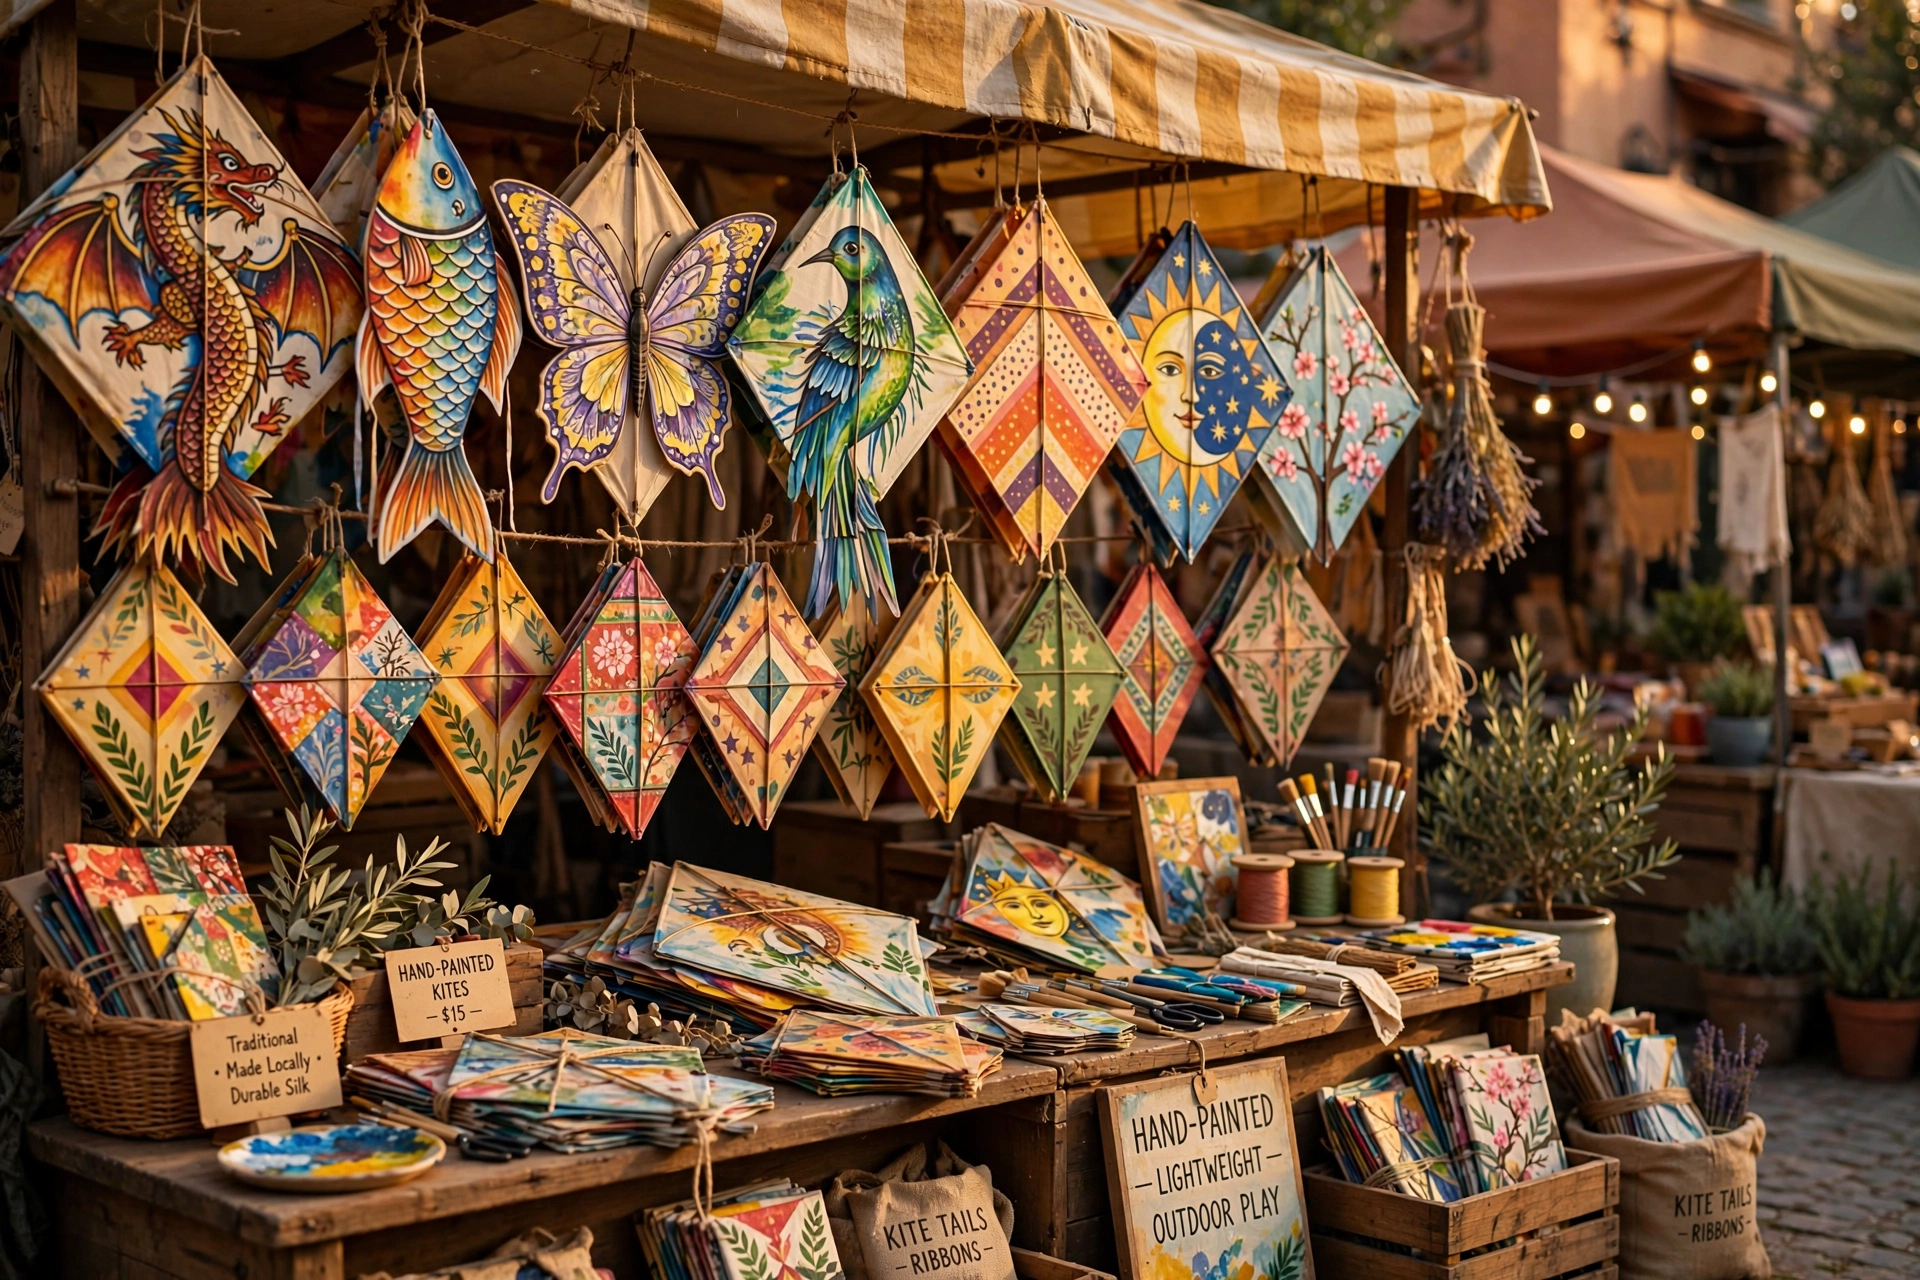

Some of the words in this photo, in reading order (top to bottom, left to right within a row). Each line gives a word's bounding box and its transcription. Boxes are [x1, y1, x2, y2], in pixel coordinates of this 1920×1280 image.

[398, 953, 494, 982] HAND-PAINTED
[432, 980, 469, 1000] KITES
[442, 1004, 466, 1024] $15
[226, 1027, 298, 1053] Traditional
[226, 1058, 263, 1079] Made
[266, 1052, 311, 1074] Locally
[231, 1081, 281, 1105] Durable
[285, 1076, 311, 1096] Silk
[1132, 1093, 1274, 1154] HAND-PAINTED
[1157, 1145, 1262, 1195] LIGHTWEIGHT
[1153, 1198, 1234, 1244] OUTDOOR
[1240, 1185, 1279, 1222] PLAY
[1675, 1192, 1714, 1218] KITE
[1720, 1183, 1752, 1212] TAILS
[883, 1218, 933, 1251] KITE
[936, 1207, 988, 1237] TAILS
[1691, 1215, 1744, 1243] RIBBONS
[910, 1240, 982, 1275] RIBBONS
